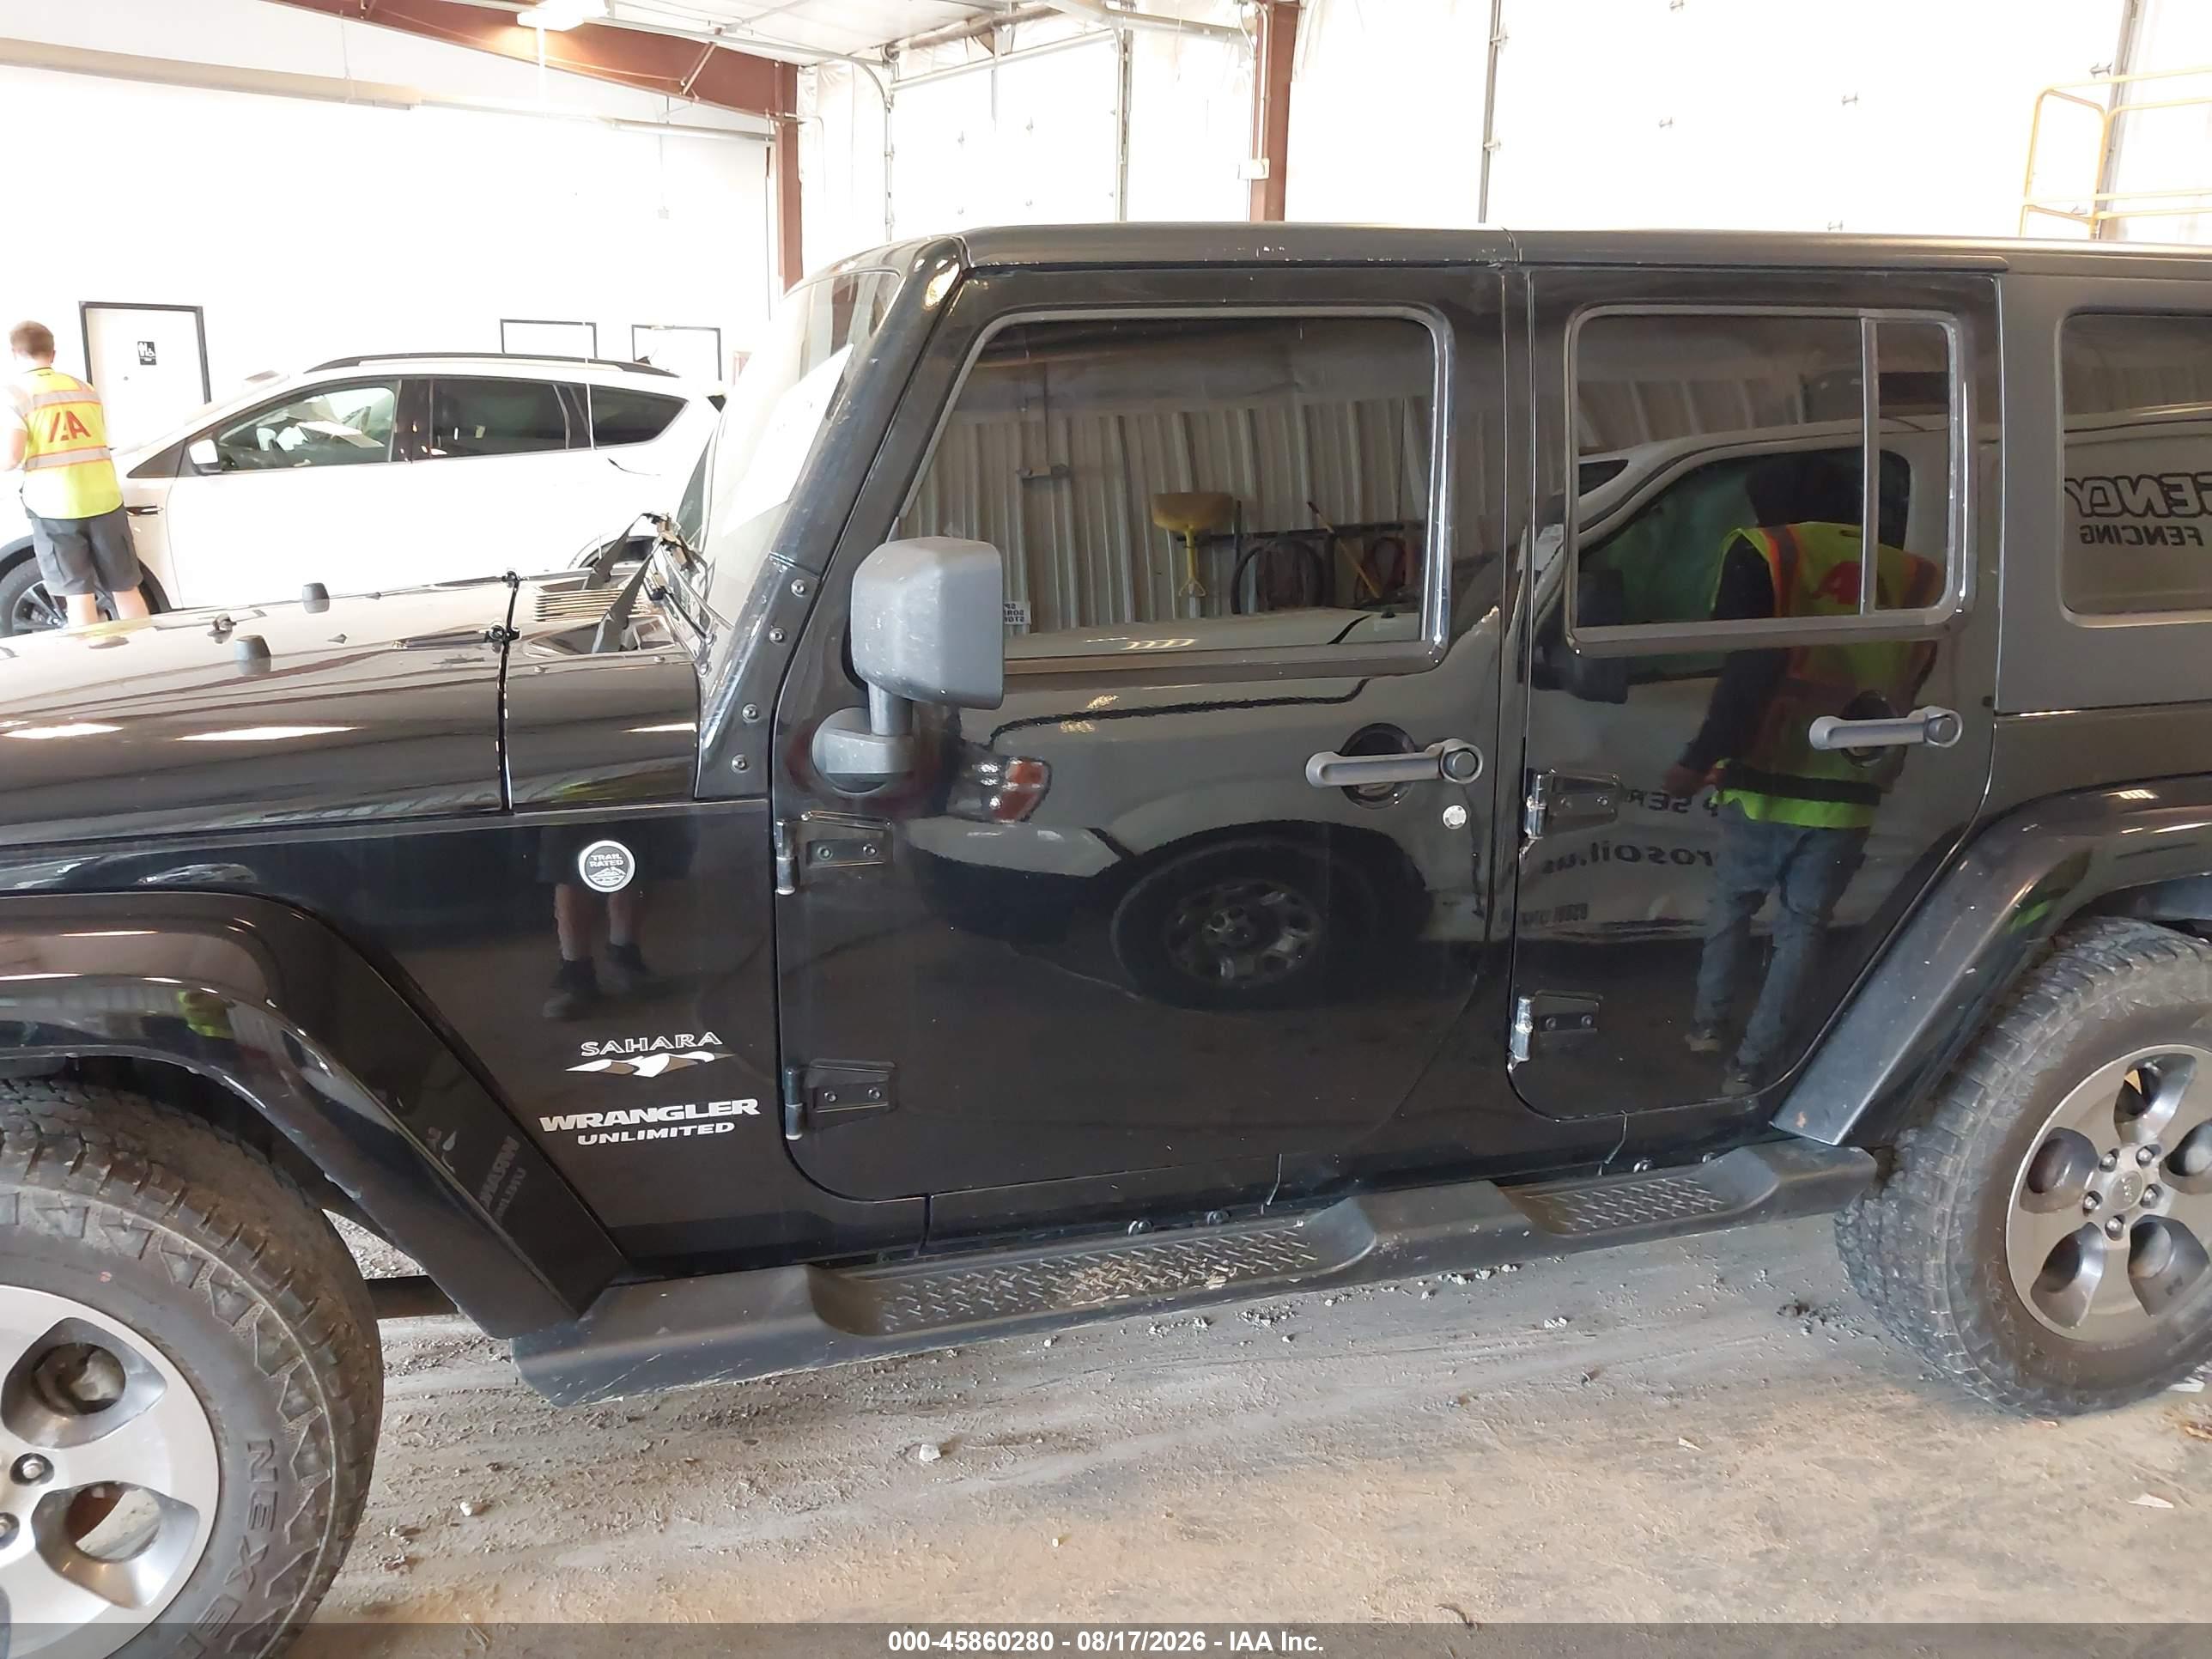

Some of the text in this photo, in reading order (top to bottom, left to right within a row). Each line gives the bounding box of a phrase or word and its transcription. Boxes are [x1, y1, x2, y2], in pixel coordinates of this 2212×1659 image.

[580, 1031, 723, 1057] SAHARA
[538, 1098, 761, 1132] WRANGLER
[577, 1122, 735, 1146] UNLIMITED
